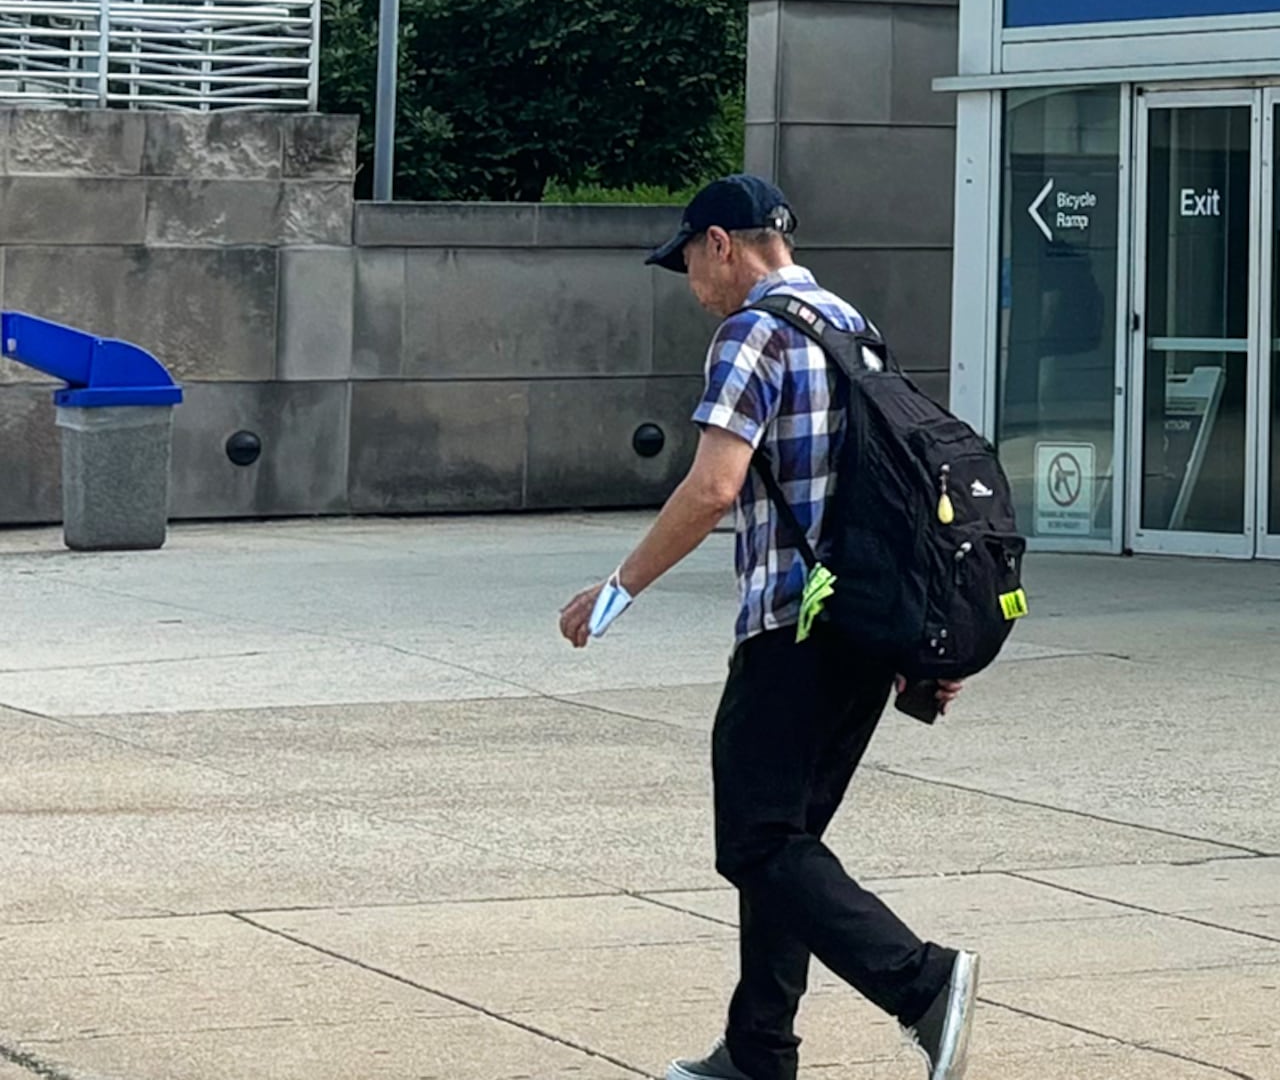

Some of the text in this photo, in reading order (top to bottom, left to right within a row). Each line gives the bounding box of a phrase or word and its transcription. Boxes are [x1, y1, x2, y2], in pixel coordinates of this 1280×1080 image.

[1056, 191, 1097, 210] Bicycle
[1180, 189, 1220, 217] Exit
[1056, 212, 1089, 230] Ramp
